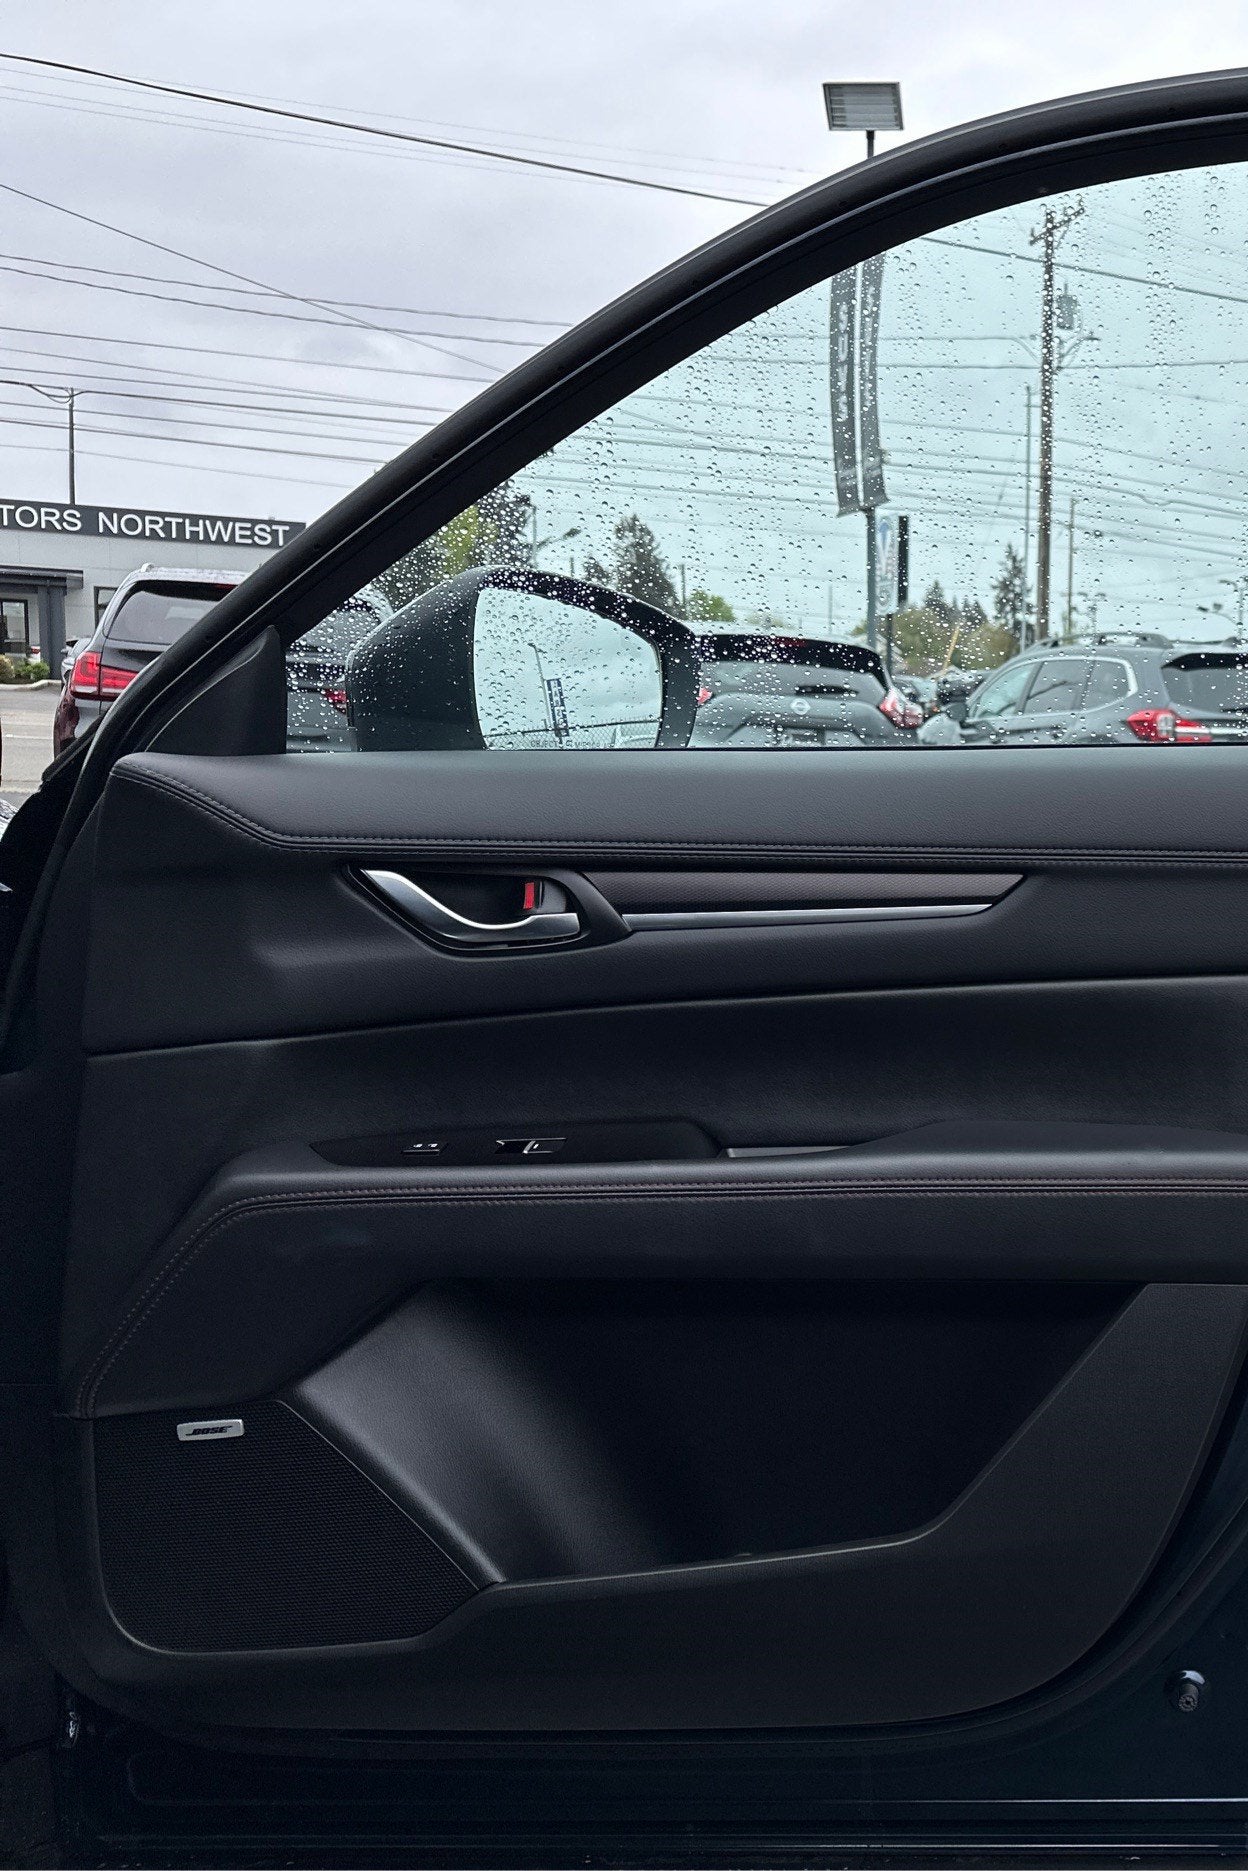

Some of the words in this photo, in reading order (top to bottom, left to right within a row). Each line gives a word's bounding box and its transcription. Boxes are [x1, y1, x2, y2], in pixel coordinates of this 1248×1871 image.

[0, 505, 82, 531] TORS
[98, 511, 290, 547] NORTHWEST
[185, 1425, 233, 1437] BOSE
